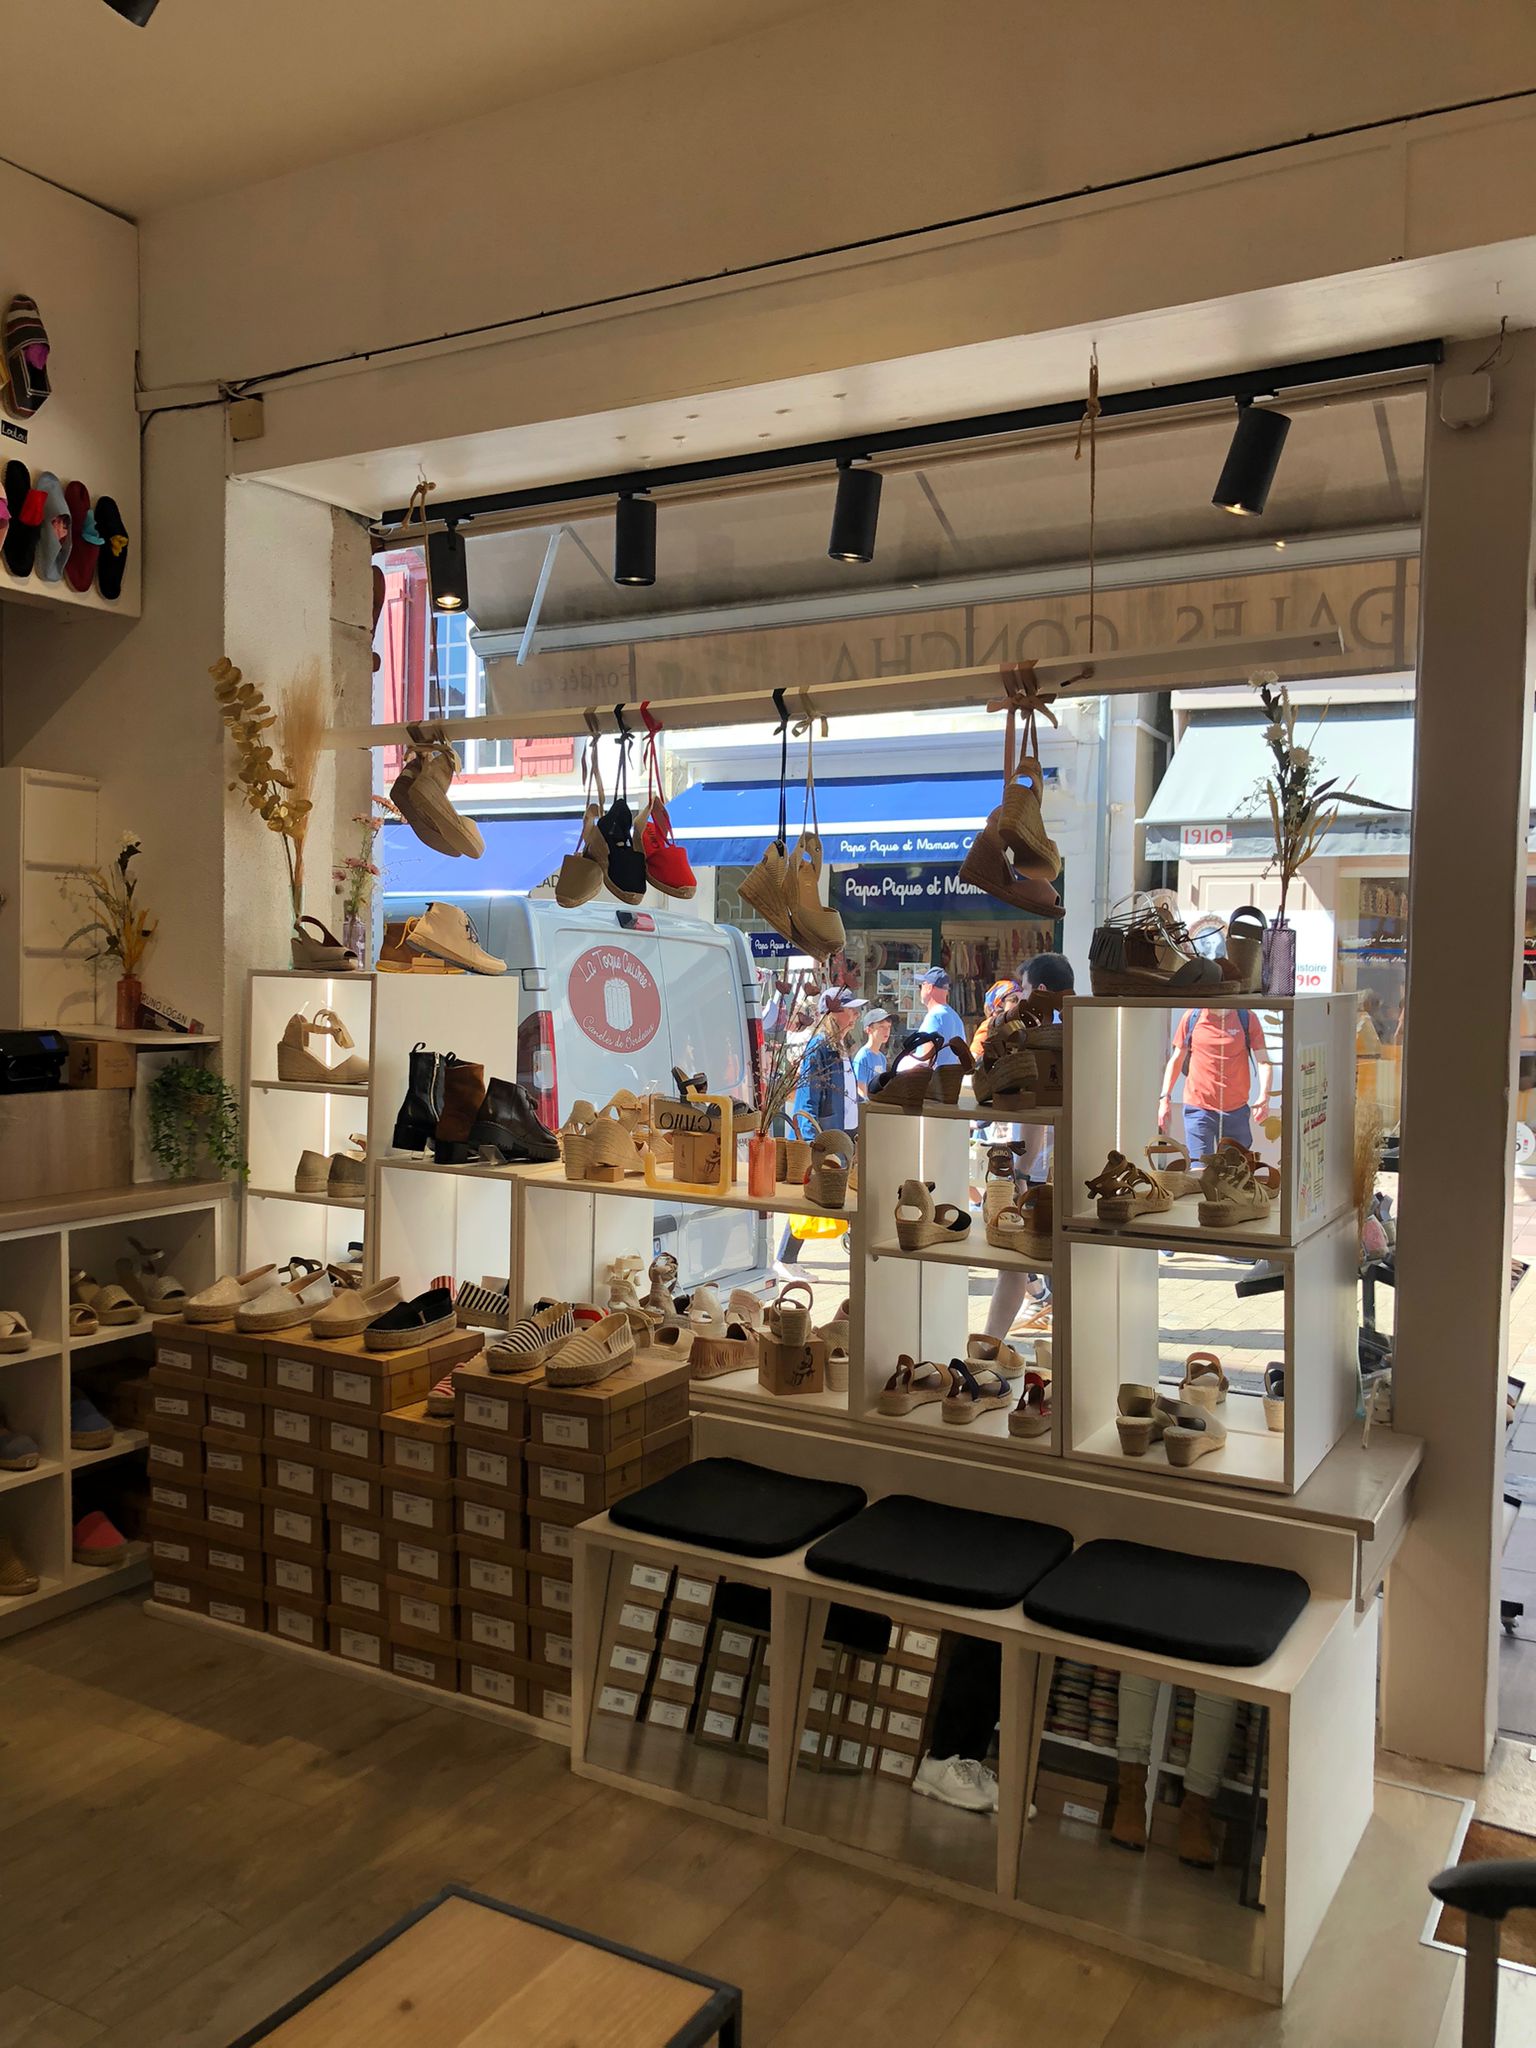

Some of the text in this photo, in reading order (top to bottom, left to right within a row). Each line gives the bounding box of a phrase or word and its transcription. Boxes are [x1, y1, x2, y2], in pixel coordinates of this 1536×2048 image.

[1183, 829, 1223, 845] 1910
[840, 839, 866, 857] Papa
[870, 839, 899, 857] Pique
[903, 838, 913, 851] et
[916, 838, 958, 850] Maman
[846, 875, 989, 906] Papa Pique et Mam
[578, 961, 597, 983] La
[592, 949, 621, 976] Toque
[1297, 963, 1327, 973] istoire
[1296, 974, 1321, 986] 910
